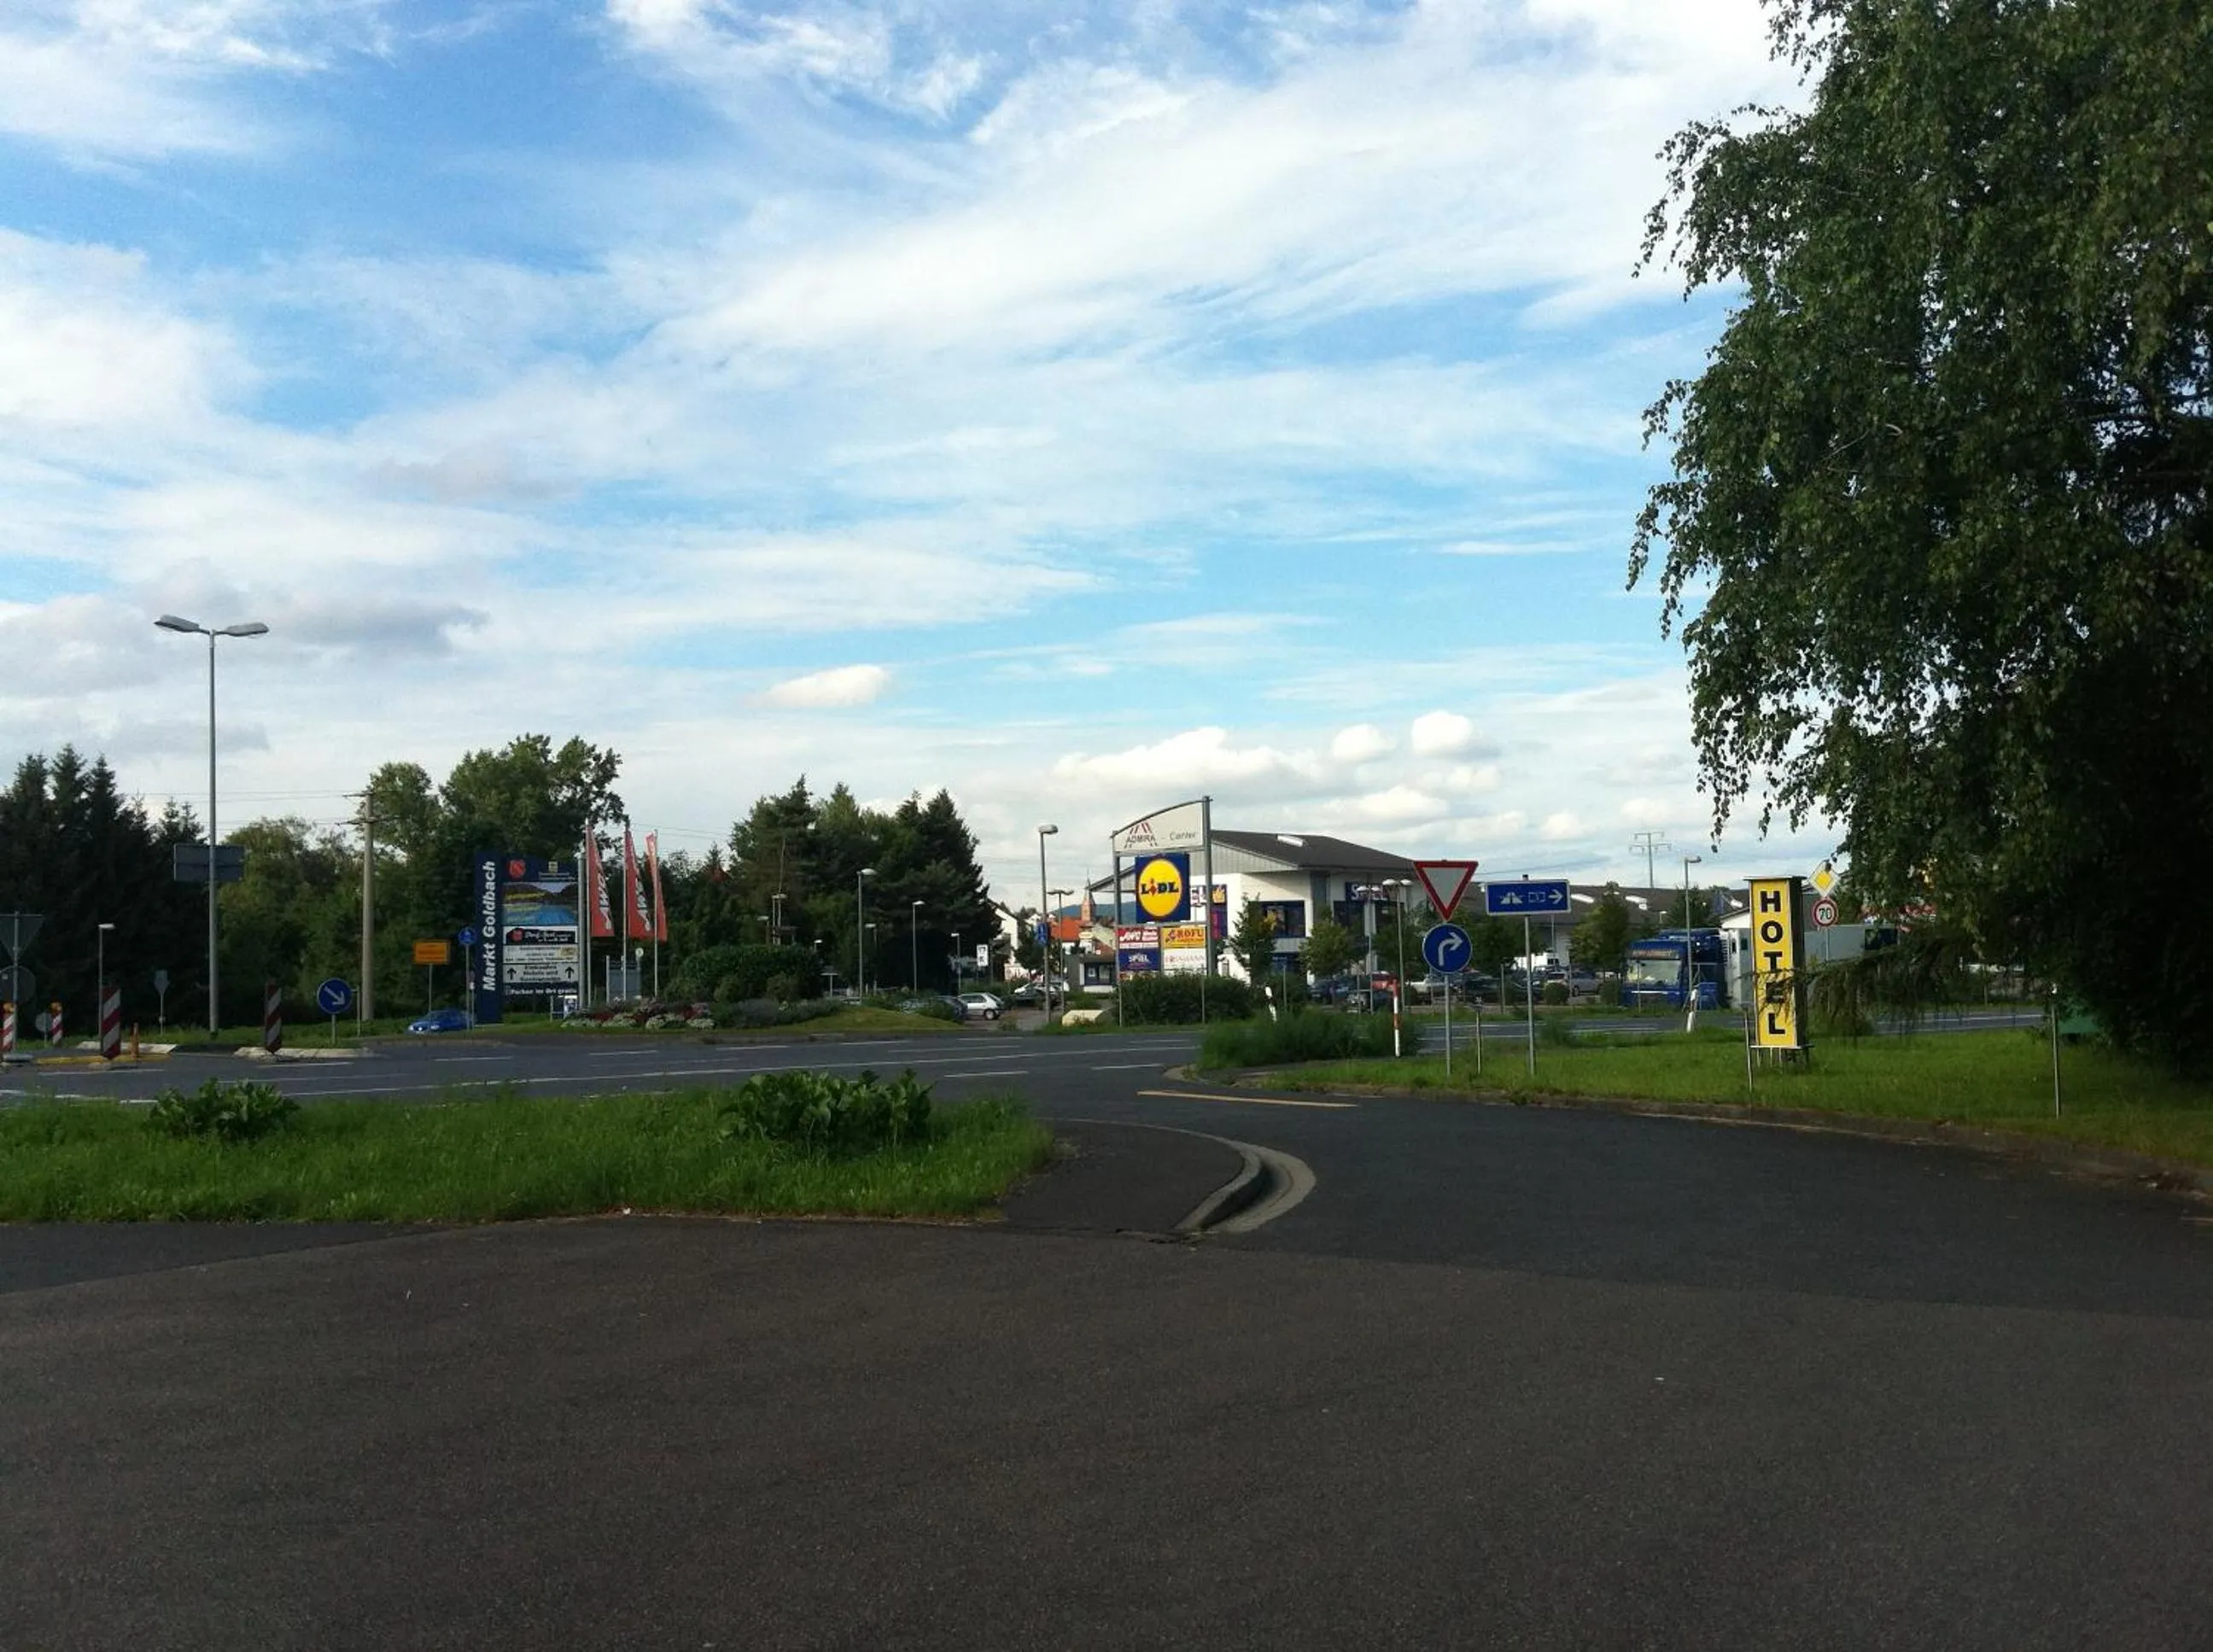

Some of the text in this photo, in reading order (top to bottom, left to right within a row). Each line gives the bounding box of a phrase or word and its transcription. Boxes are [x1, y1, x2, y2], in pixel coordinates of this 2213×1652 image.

[482, 861, 495, 991] Markt Goldbach
[1177, 928, 1203, 937] ROFU
[1819, 908, 1831, 919] 70
[1760, 890, 1786, 1035] HOTEL
